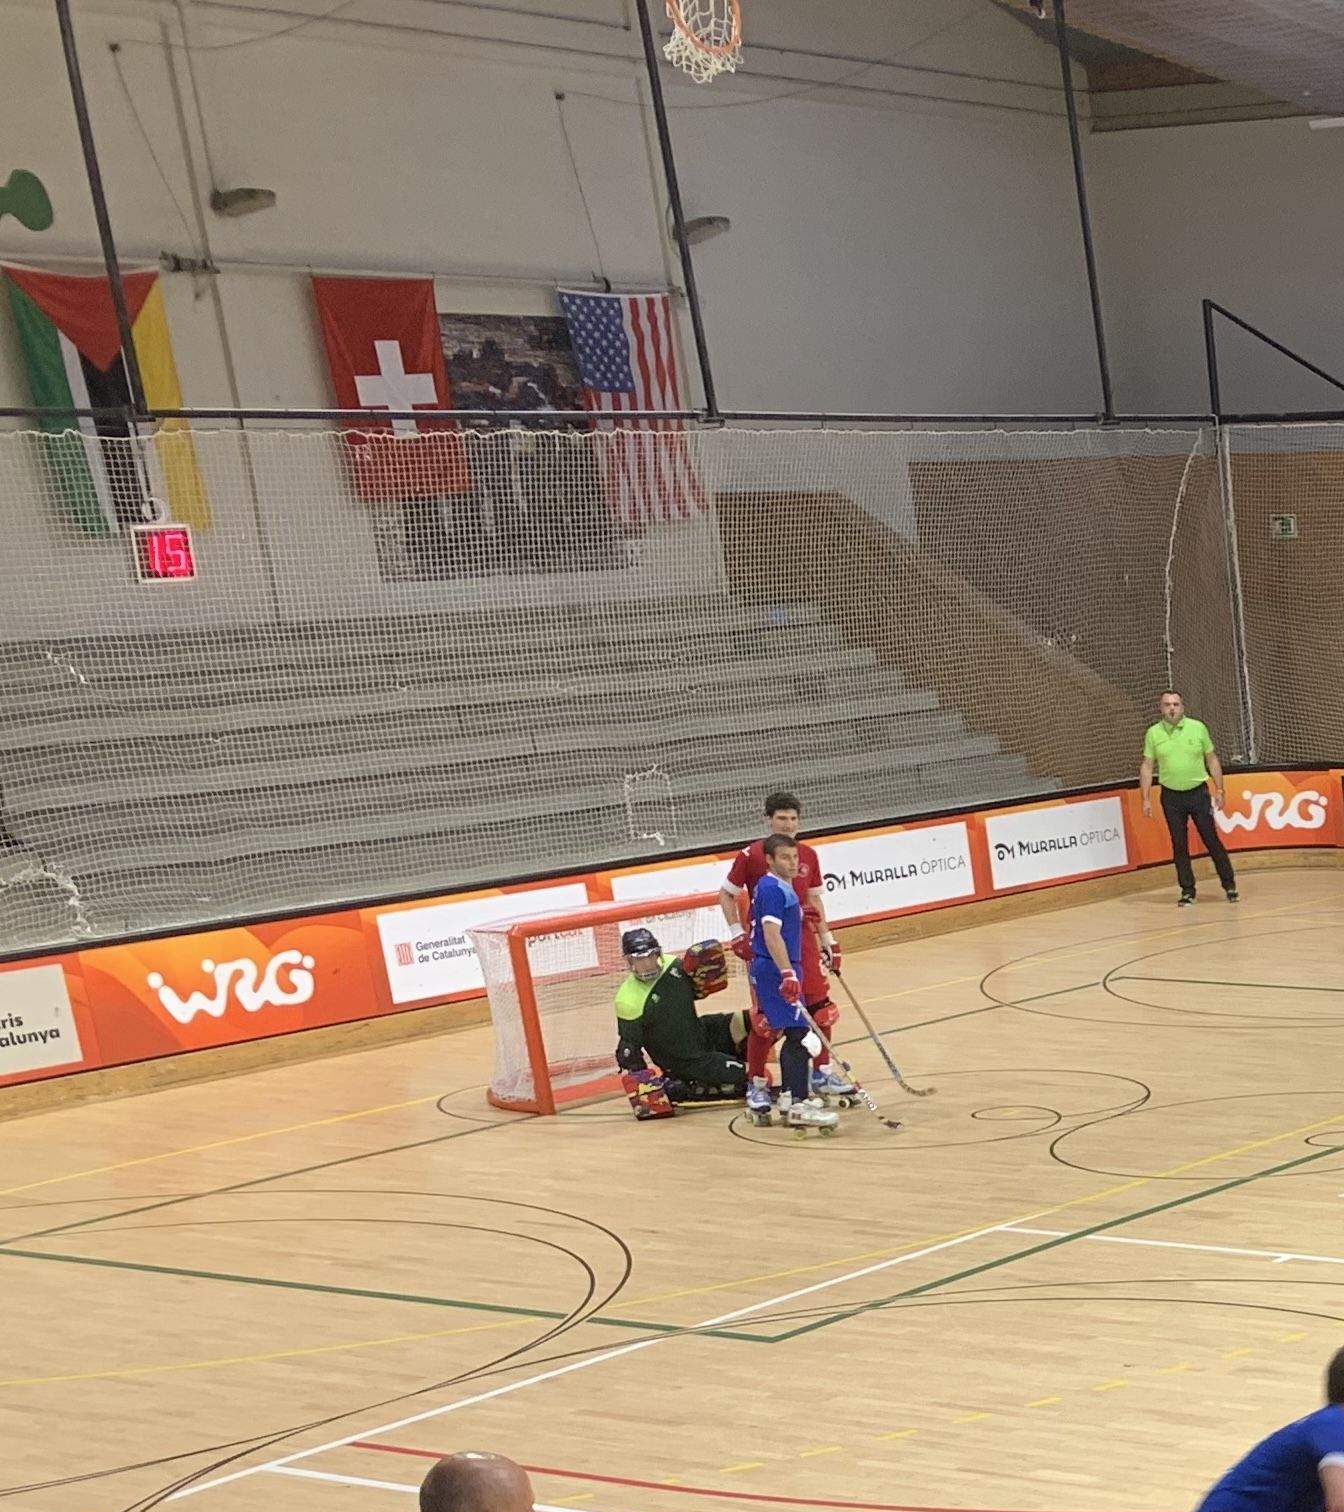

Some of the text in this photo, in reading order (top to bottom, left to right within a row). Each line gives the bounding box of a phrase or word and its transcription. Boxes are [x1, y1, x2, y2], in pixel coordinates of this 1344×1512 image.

[150, 532, 188, 575] 15
[1018, 835, 1078, 857] MURALLA
[1079, 827, 1120, 846] ÒPTICA
[850, 864, 918, 888] MURALLA
[920, 855, 967, 876] ÒPTICA
[415, 935, 466, 951] Generalitat
[418, 953, 430, 963] de
